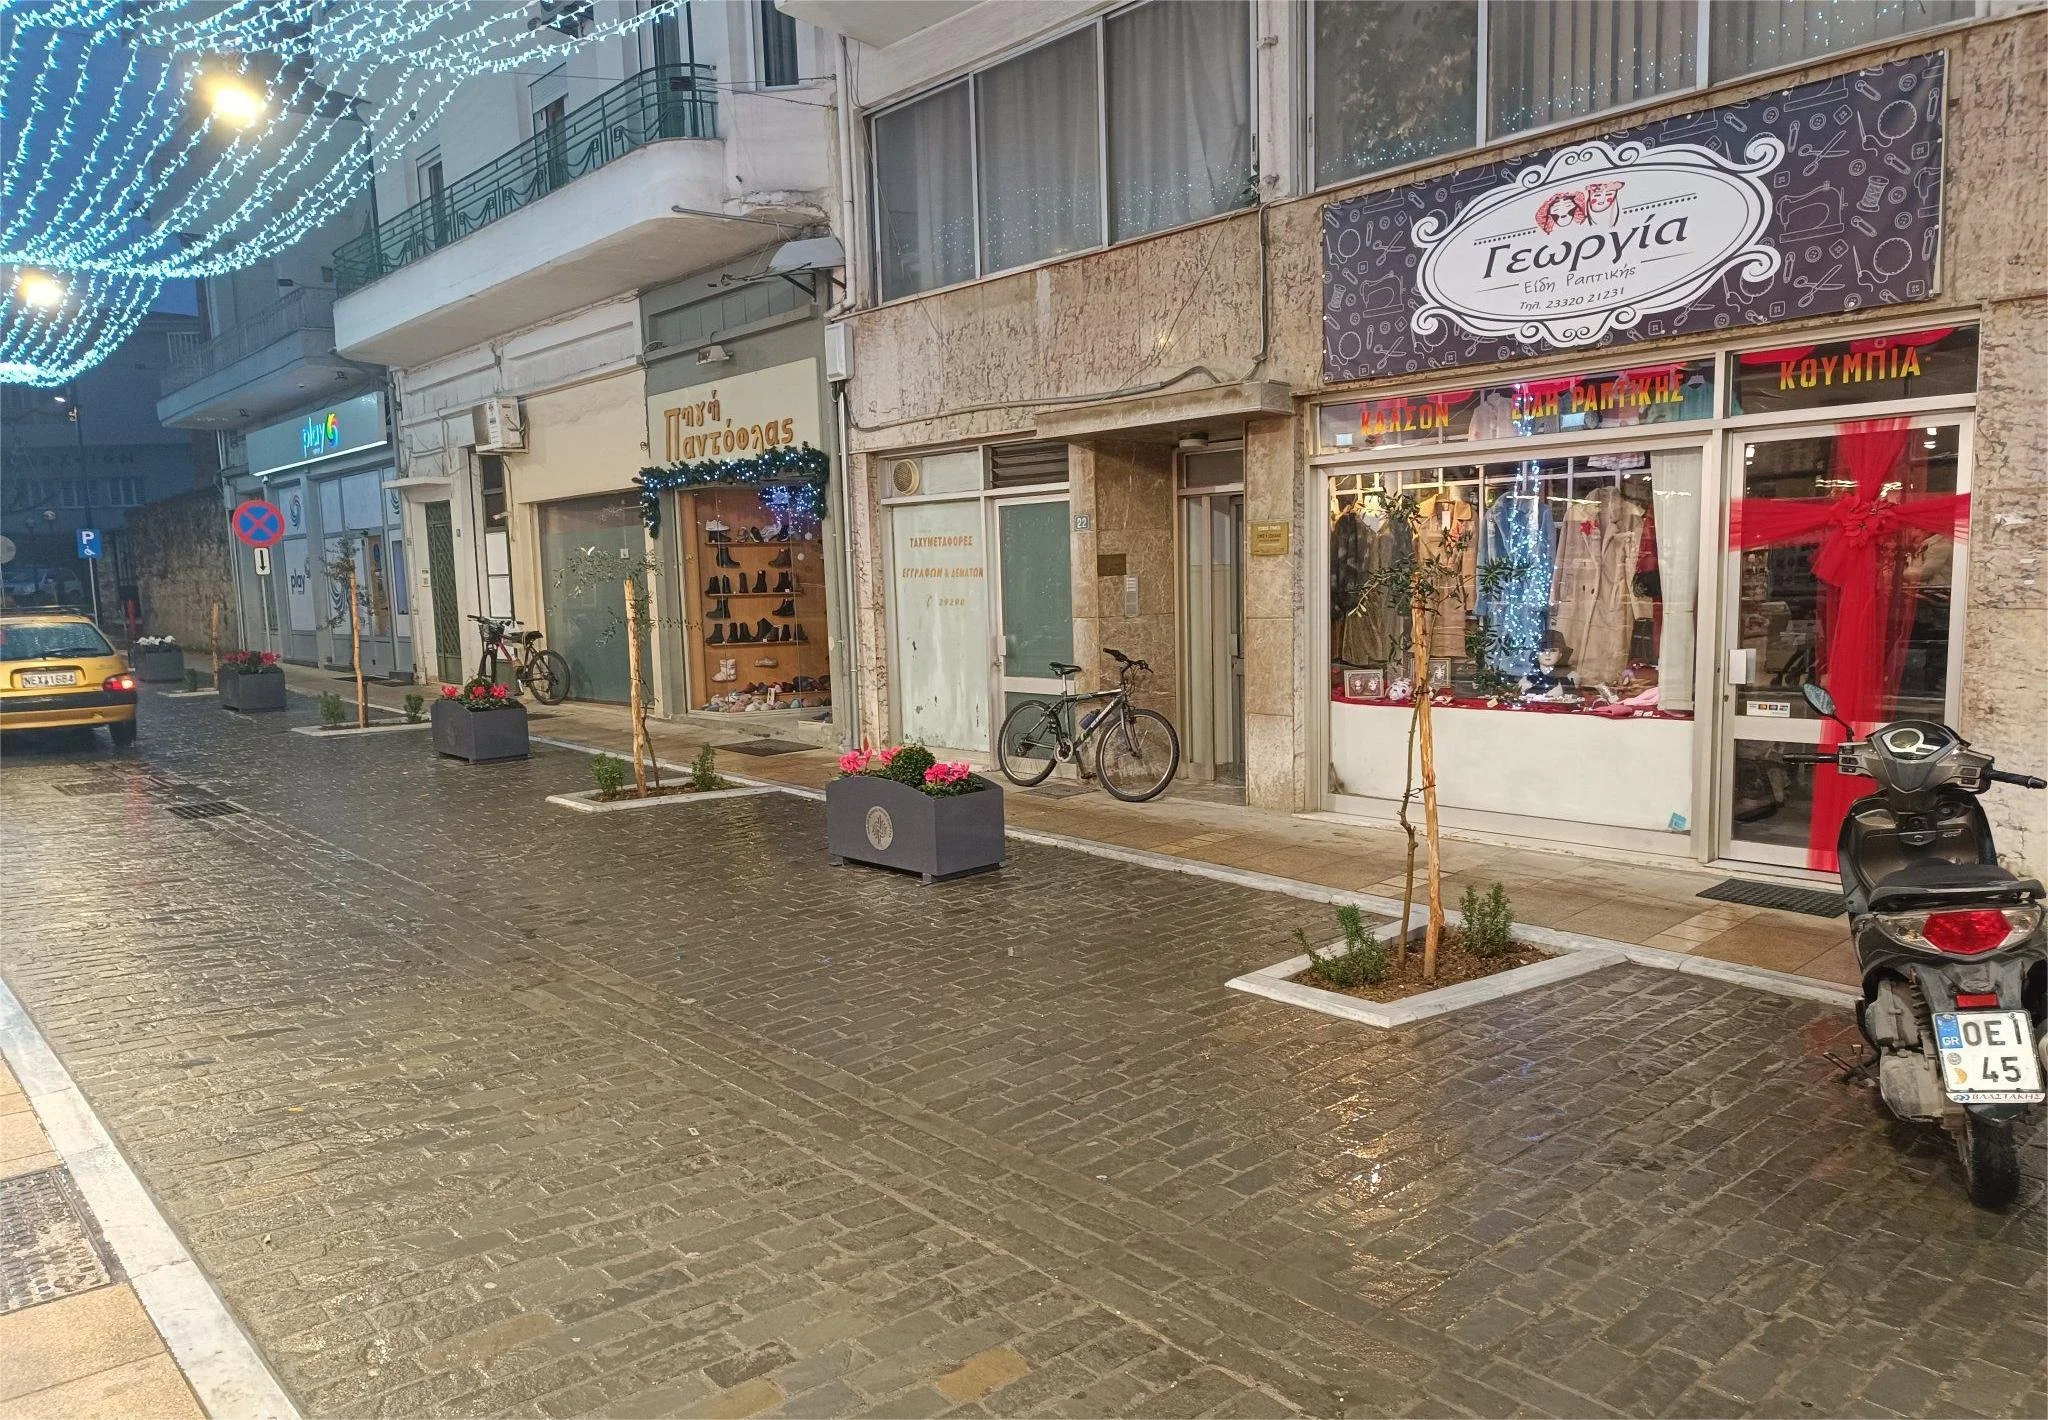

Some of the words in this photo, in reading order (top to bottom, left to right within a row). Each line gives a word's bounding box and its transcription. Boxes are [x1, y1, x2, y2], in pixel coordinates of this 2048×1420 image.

[1482, 214, 1689, 279] Γεωργία
[1524, 276, 1556, 294] Είδη
[1566, 263, 1636, 287] Ραπτικής
[1519, 300, 1542, 311] Τηλ.
[1545, 295, 1584, 309] 23320
[1588, 286, 1625, 304] 21231
[1779, 345, 1921, 391] ΚΟΥΜΠΙΑ
[1571, 371, 1685, 413] ΡΑΠΤΙΚΗΣ
[1076, 517, 1088, 529] 22
[81, 530, 95, 545] P
[909, 535, 973, 548] ΤΑΧΥΜΕΤΑΦΟΡΕΣ
[902, 567, 943, 579] ΕΓΓΡΑΦΩΝ
[951, 567, 984, 578] ΔΕΜΑΤΩΝ
[1941, 1036, 1960, 1046] GR
[1982, 1056, 2022, 1083] 45
